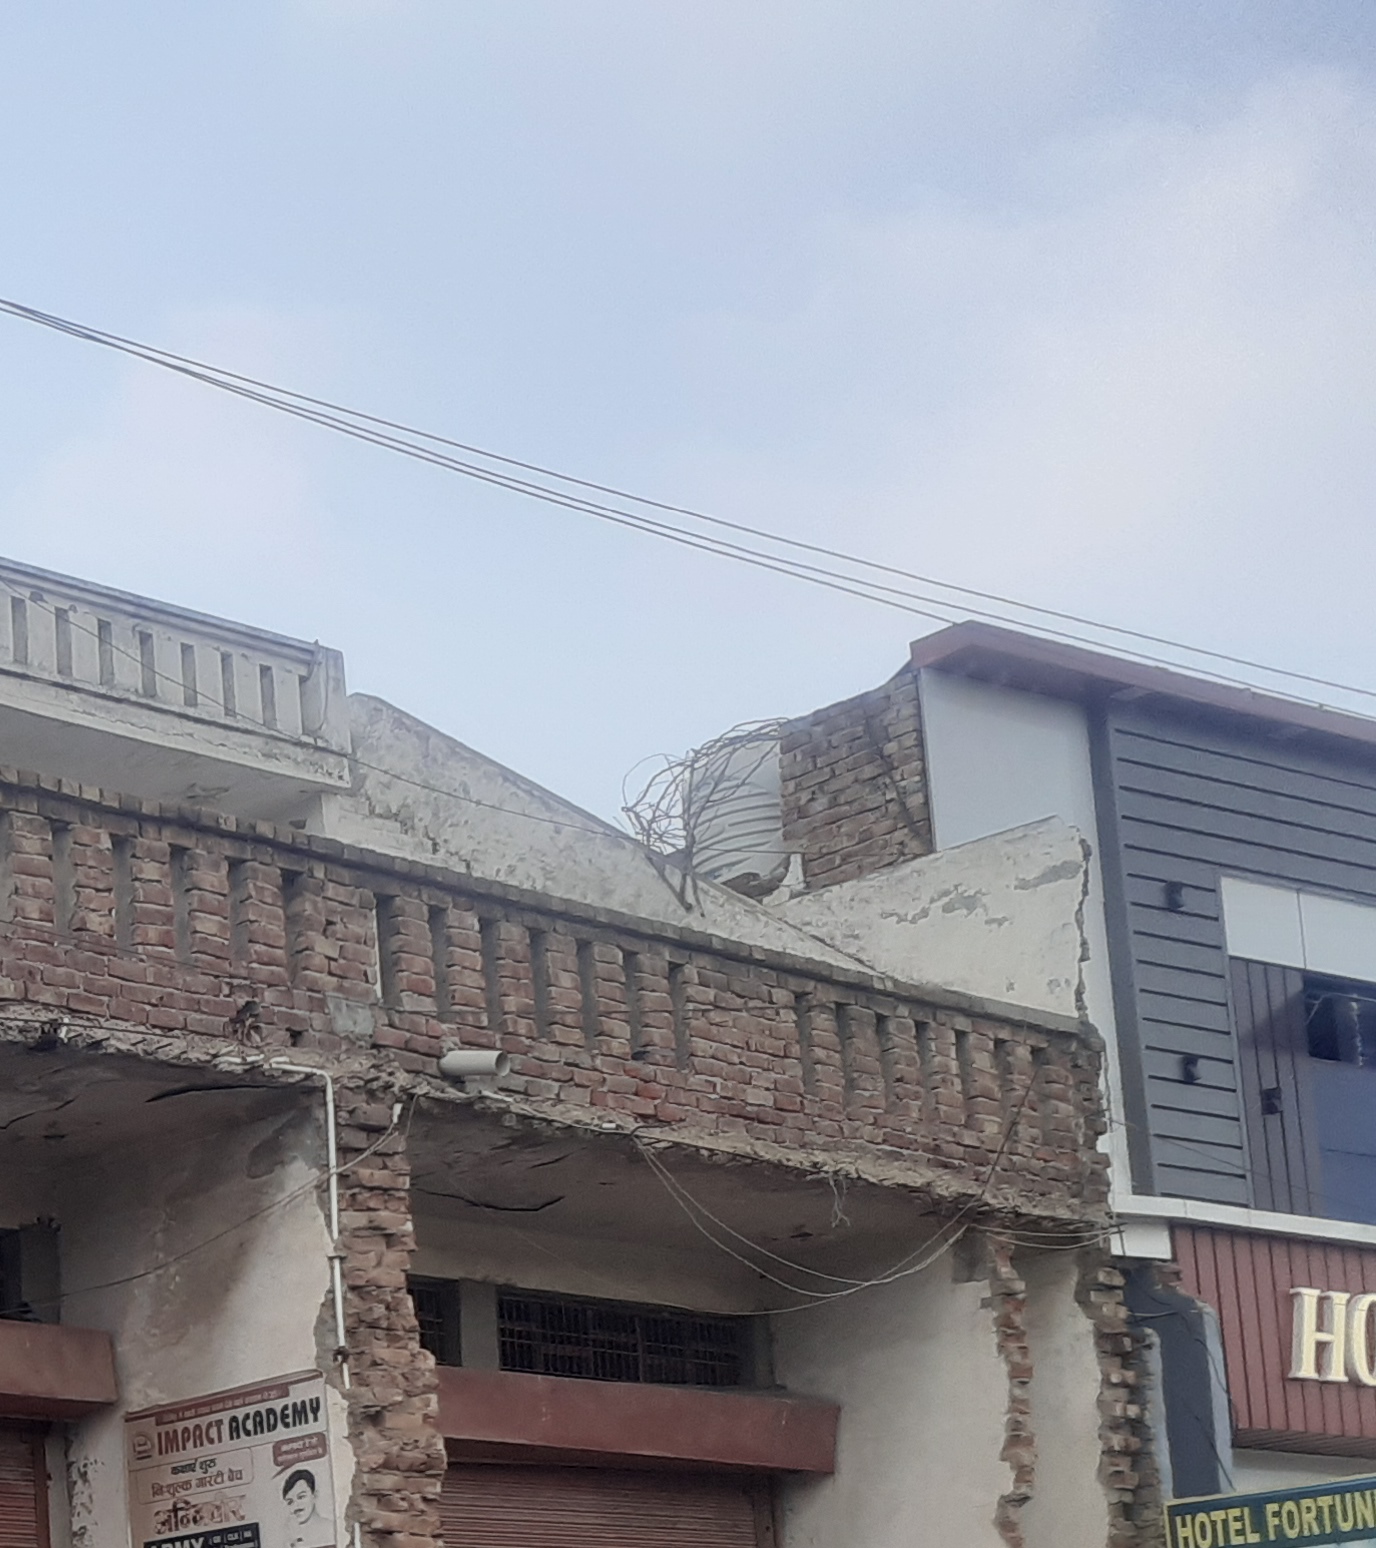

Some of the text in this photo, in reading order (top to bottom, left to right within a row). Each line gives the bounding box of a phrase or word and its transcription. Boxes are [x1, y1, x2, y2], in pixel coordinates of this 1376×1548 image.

[157, 1418, 224, 1456] IMPACT
[228, 1396, 321, 1441] ACADEMY
[1265, 1489, 1376, 1541] FORTUN
